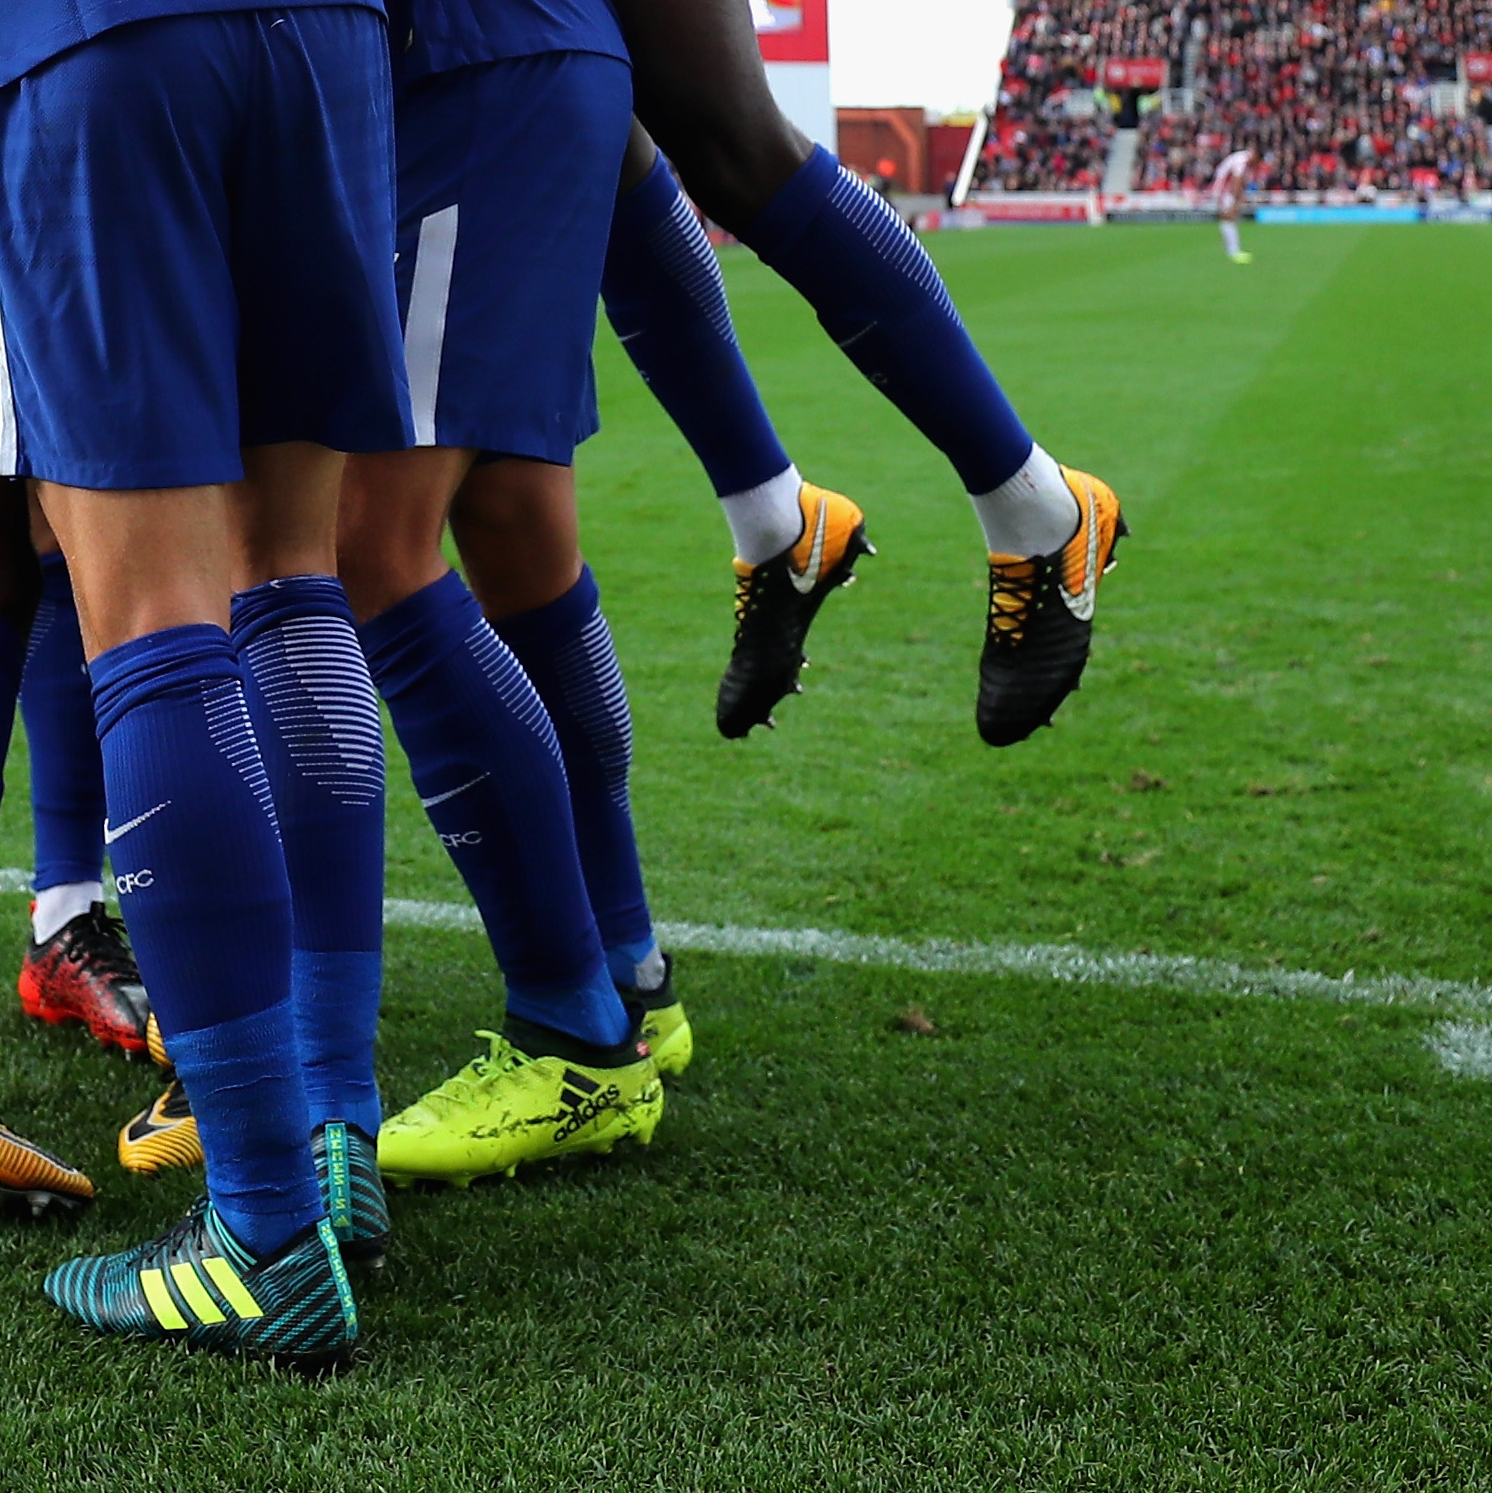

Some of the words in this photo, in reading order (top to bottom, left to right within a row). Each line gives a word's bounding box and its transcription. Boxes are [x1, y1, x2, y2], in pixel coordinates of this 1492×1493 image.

[116, 868, 155, 895] CFC
[553, 1084, 620, 1142] adidas
[328, 1126, 347, 1210] NEMESIS
